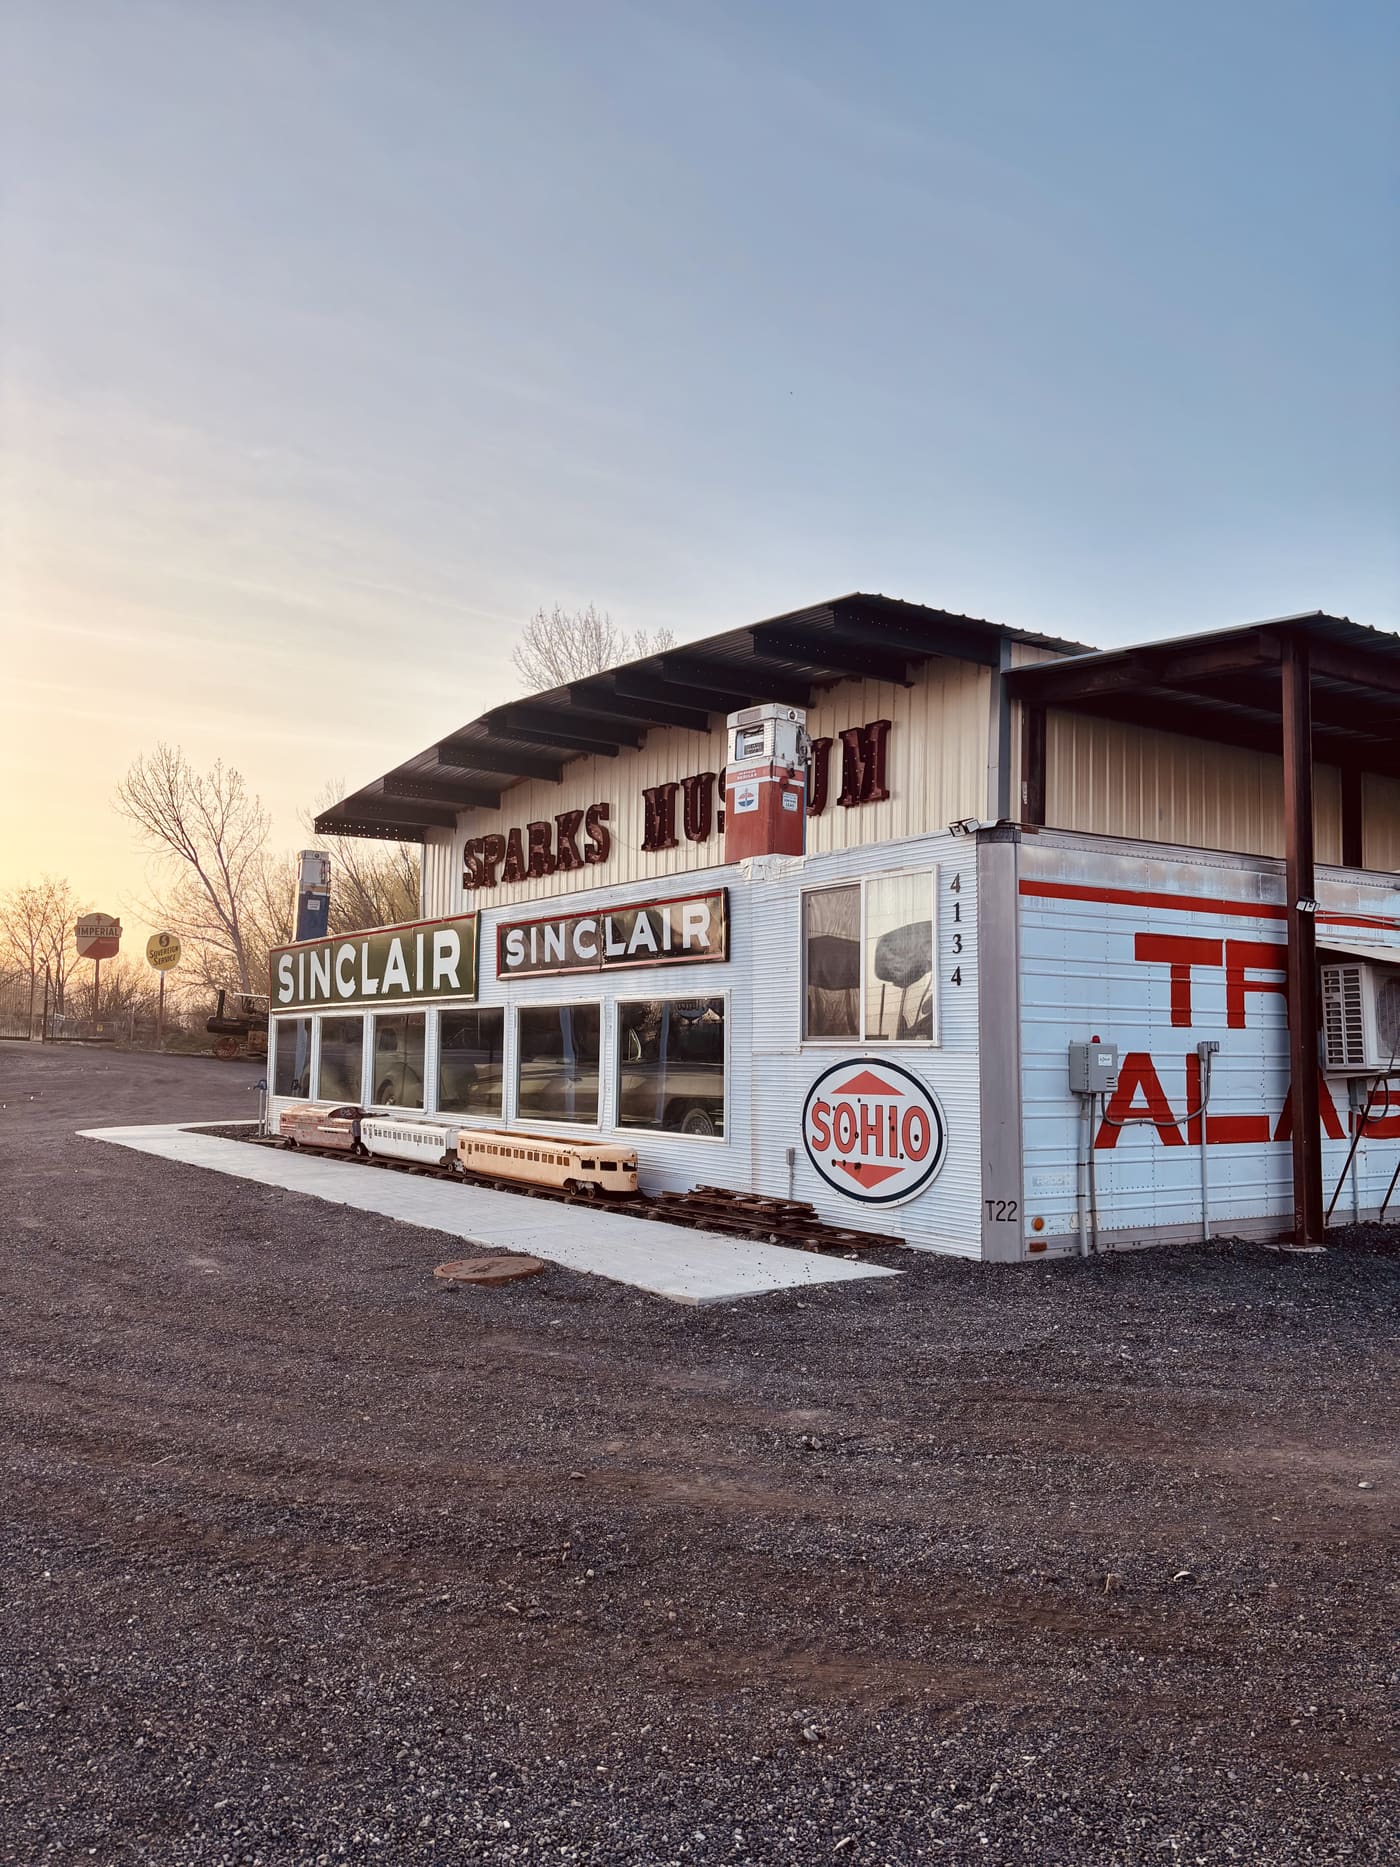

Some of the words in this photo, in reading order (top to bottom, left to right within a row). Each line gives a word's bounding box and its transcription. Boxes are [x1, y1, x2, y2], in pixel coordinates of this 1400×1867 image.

[462, 803, 611, 890] SPARKS
[641, 719, 892, 852] MUUM
[78, 927, 119, 937] IMPERIAL
[505, 905, 711, 967] SINCLAIR
[950, 872, 962, 986] 4134
[153, 954, 176, 966] SERVICE
[278, 929, 461, 1003] SINCLAIR
[811, 1101, 931, 1162] SOHIO
[985, 1200, 1018, 1222] T22
